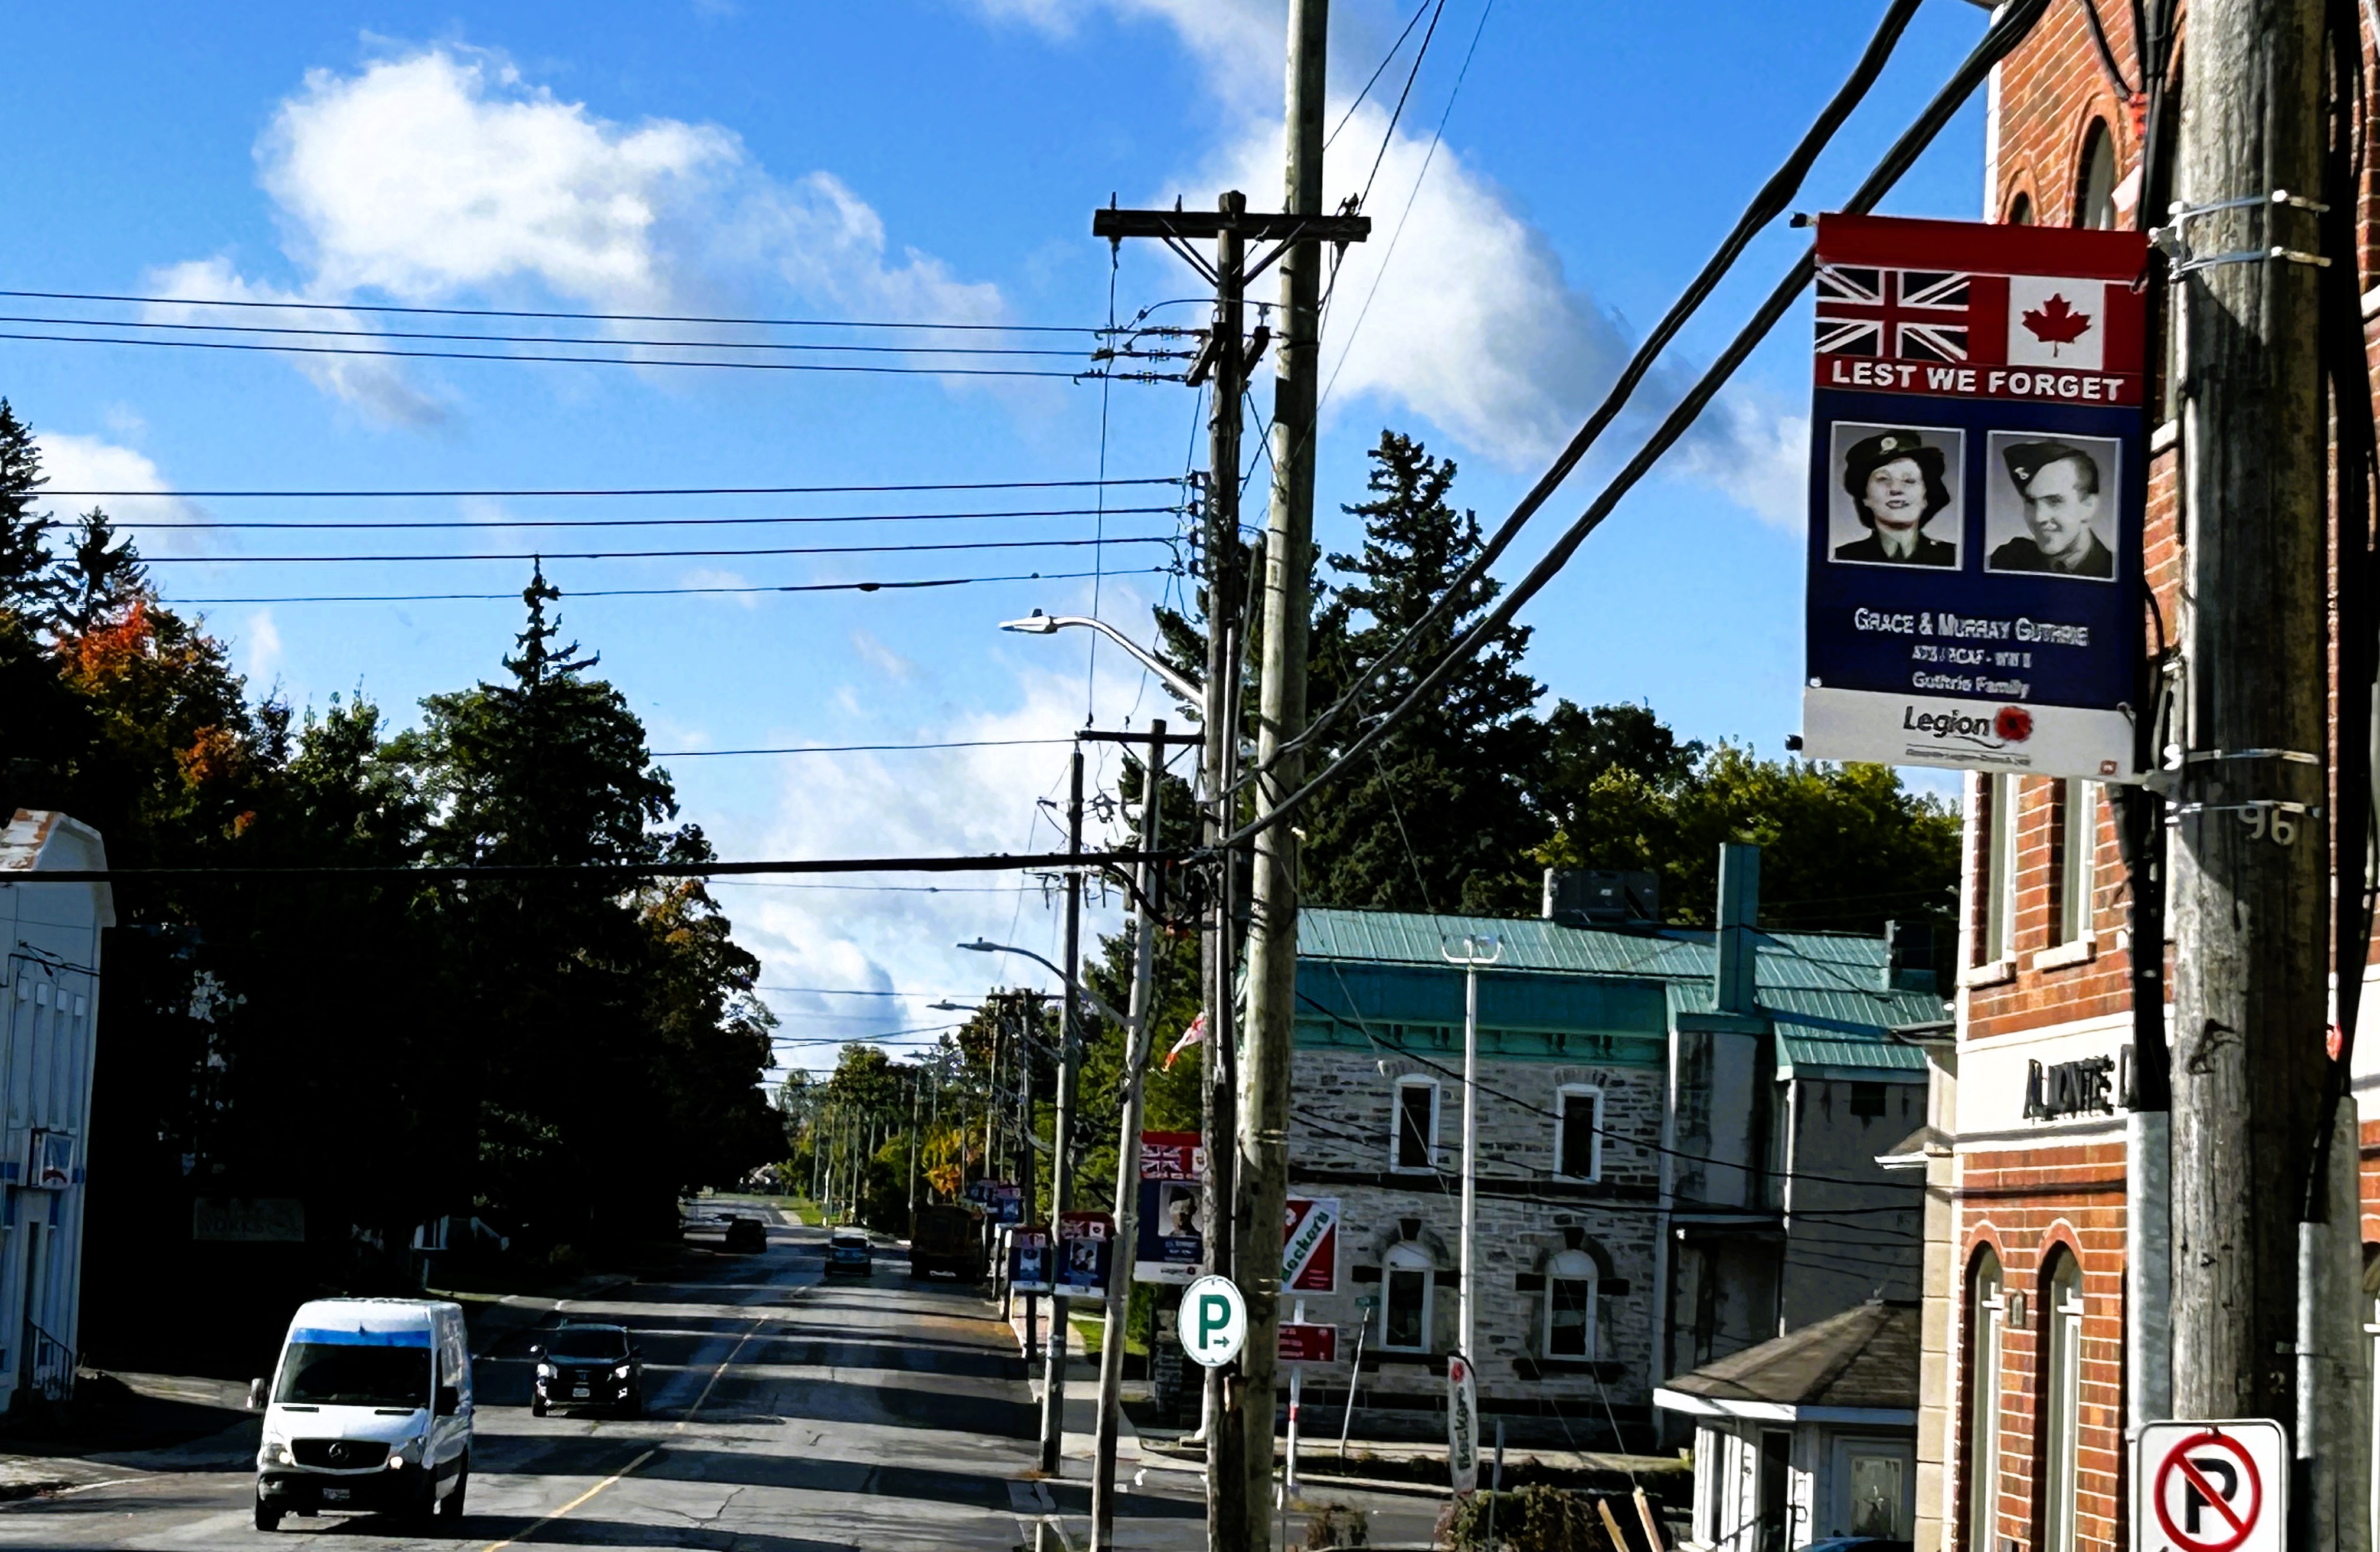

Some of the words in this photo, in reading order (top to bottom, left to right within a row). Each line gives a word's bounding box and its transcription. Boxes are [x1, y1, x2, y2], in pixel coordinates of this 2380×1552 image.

[1832, 360, 1917, 388] LEST
[1926, 366, 1977, 393] WE
[1988, 371, 2125, 401] FORGET
[1854, 607, 1915, 634] GRACE
[1918, 611, 1933, 636] &
[1911, 670, 1972, 692] Guthrie
[1975, 676, 2031, 700] Family
[1903, 705, 1990, 738] Legion
[2238, 805, 2296, 846] 96
[1199, 1294, 1231, 1350] P
